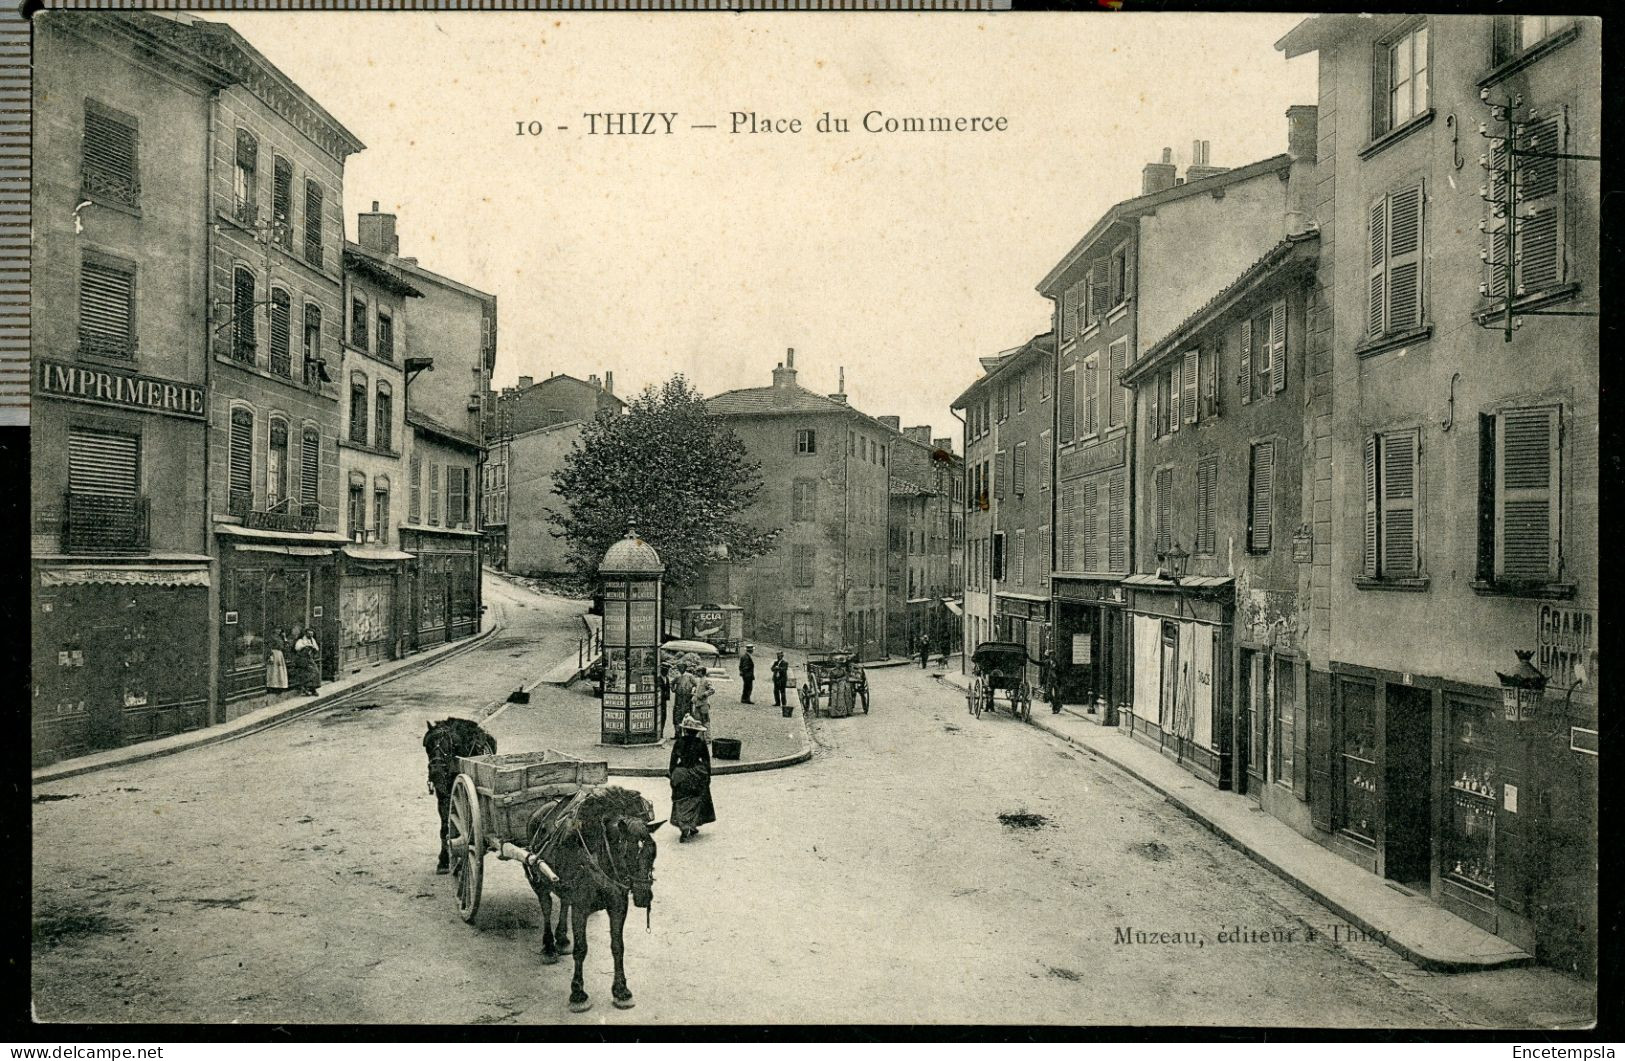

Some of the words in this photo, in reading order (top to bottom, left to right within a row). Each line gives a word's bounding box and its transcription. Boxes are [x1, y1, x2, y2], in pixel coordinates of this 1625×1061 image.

[516, 121, 543, 136] 10
[583, 112, 678, 135] THIZY
[730, 111, 802, 134] Place
[816, 111, 849, 133] du
[862, 110, 1008, 133] Commerce
[43, 363, 204, 414] IMPRIMERIE
[1540, 605, 1593, 646] GRAND
[1217, 924, 1297, 944] éditeur
[1327, 923, 1392, 949] Thizy
